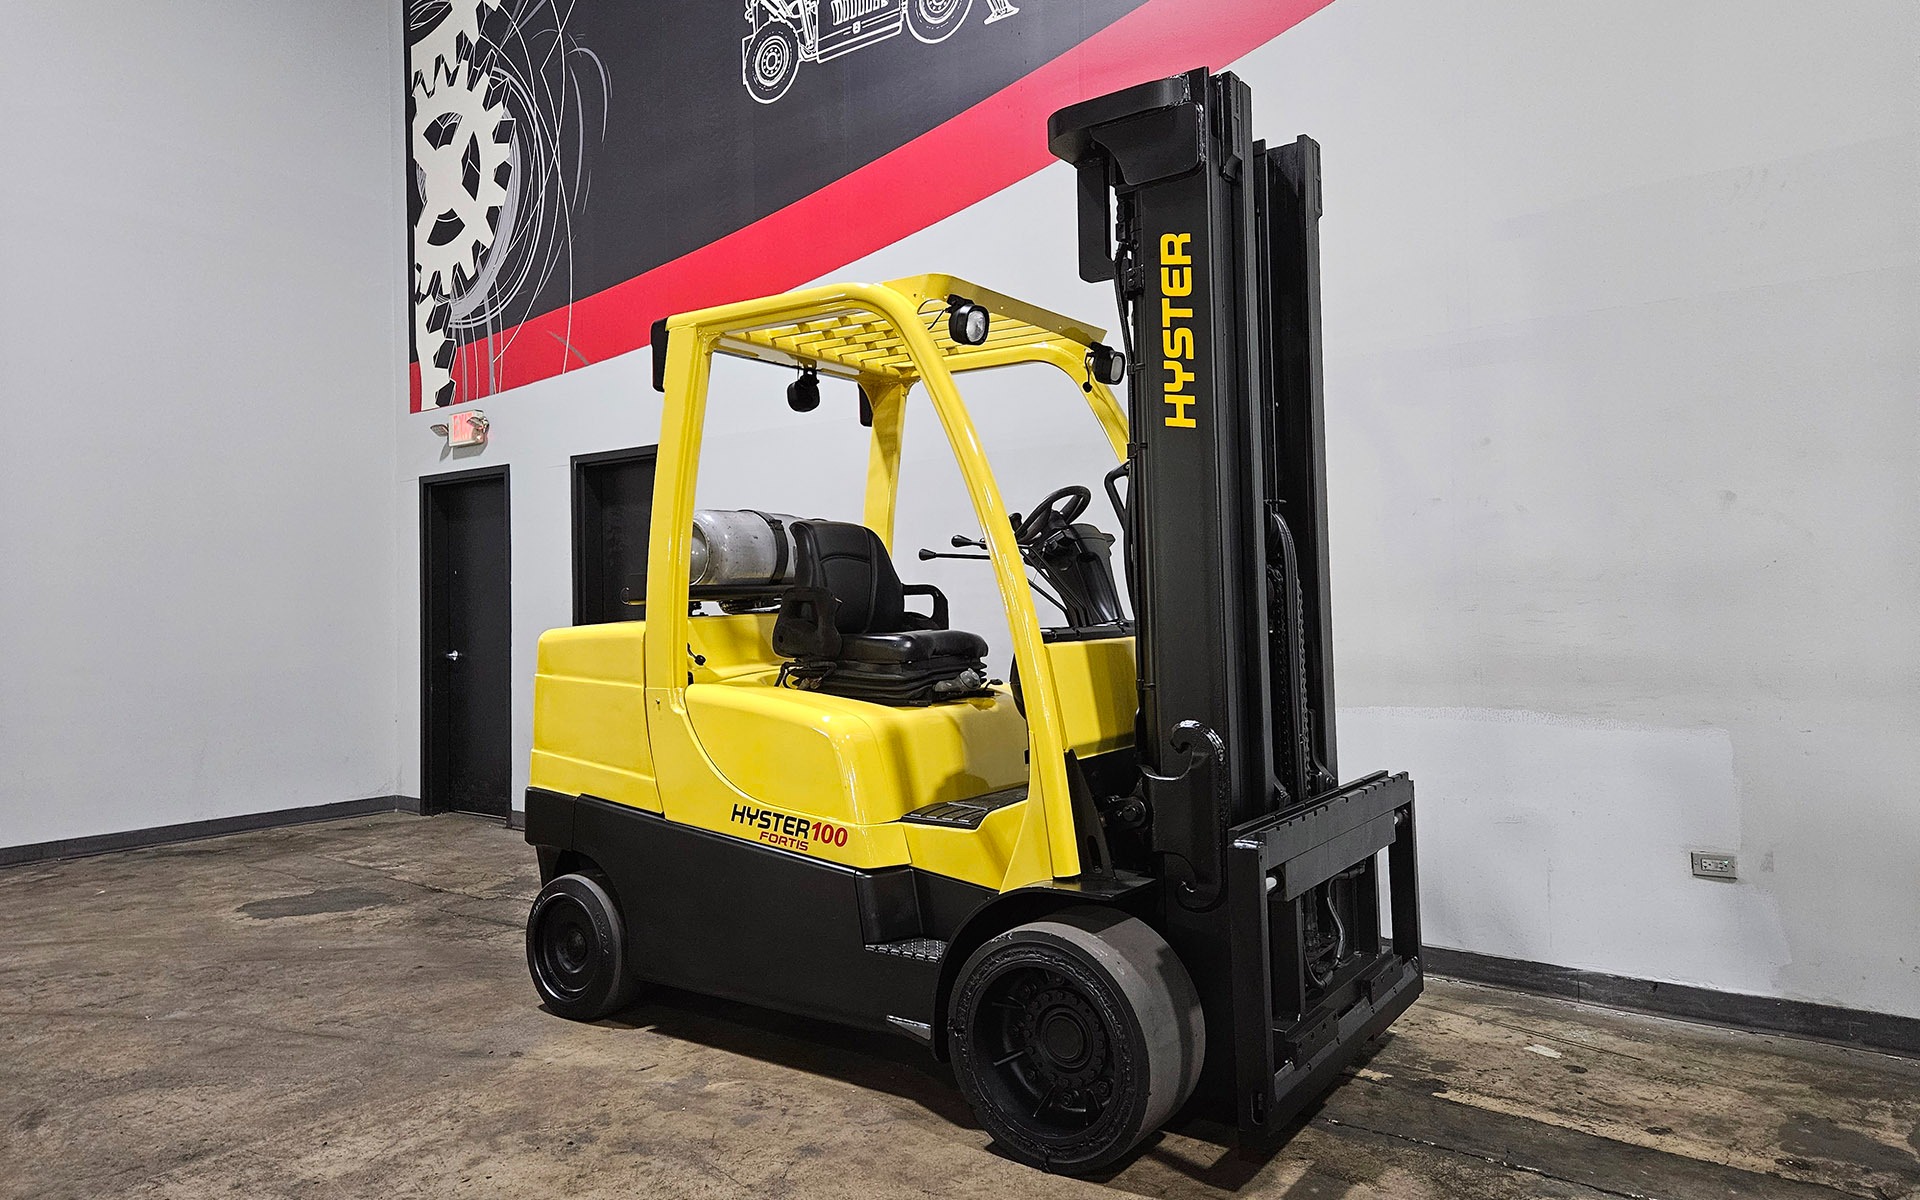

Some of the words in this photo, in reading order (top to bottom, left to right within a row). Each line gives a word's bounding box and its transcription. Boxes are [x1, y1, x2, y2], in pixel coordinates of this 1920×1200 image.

[1160, 233, 1196, 428] HYSTER
[731, 803, 810, 839] HYSTER
[811, 821, 848, 847] 100
[759, 831, 809, 851] FORTIS
